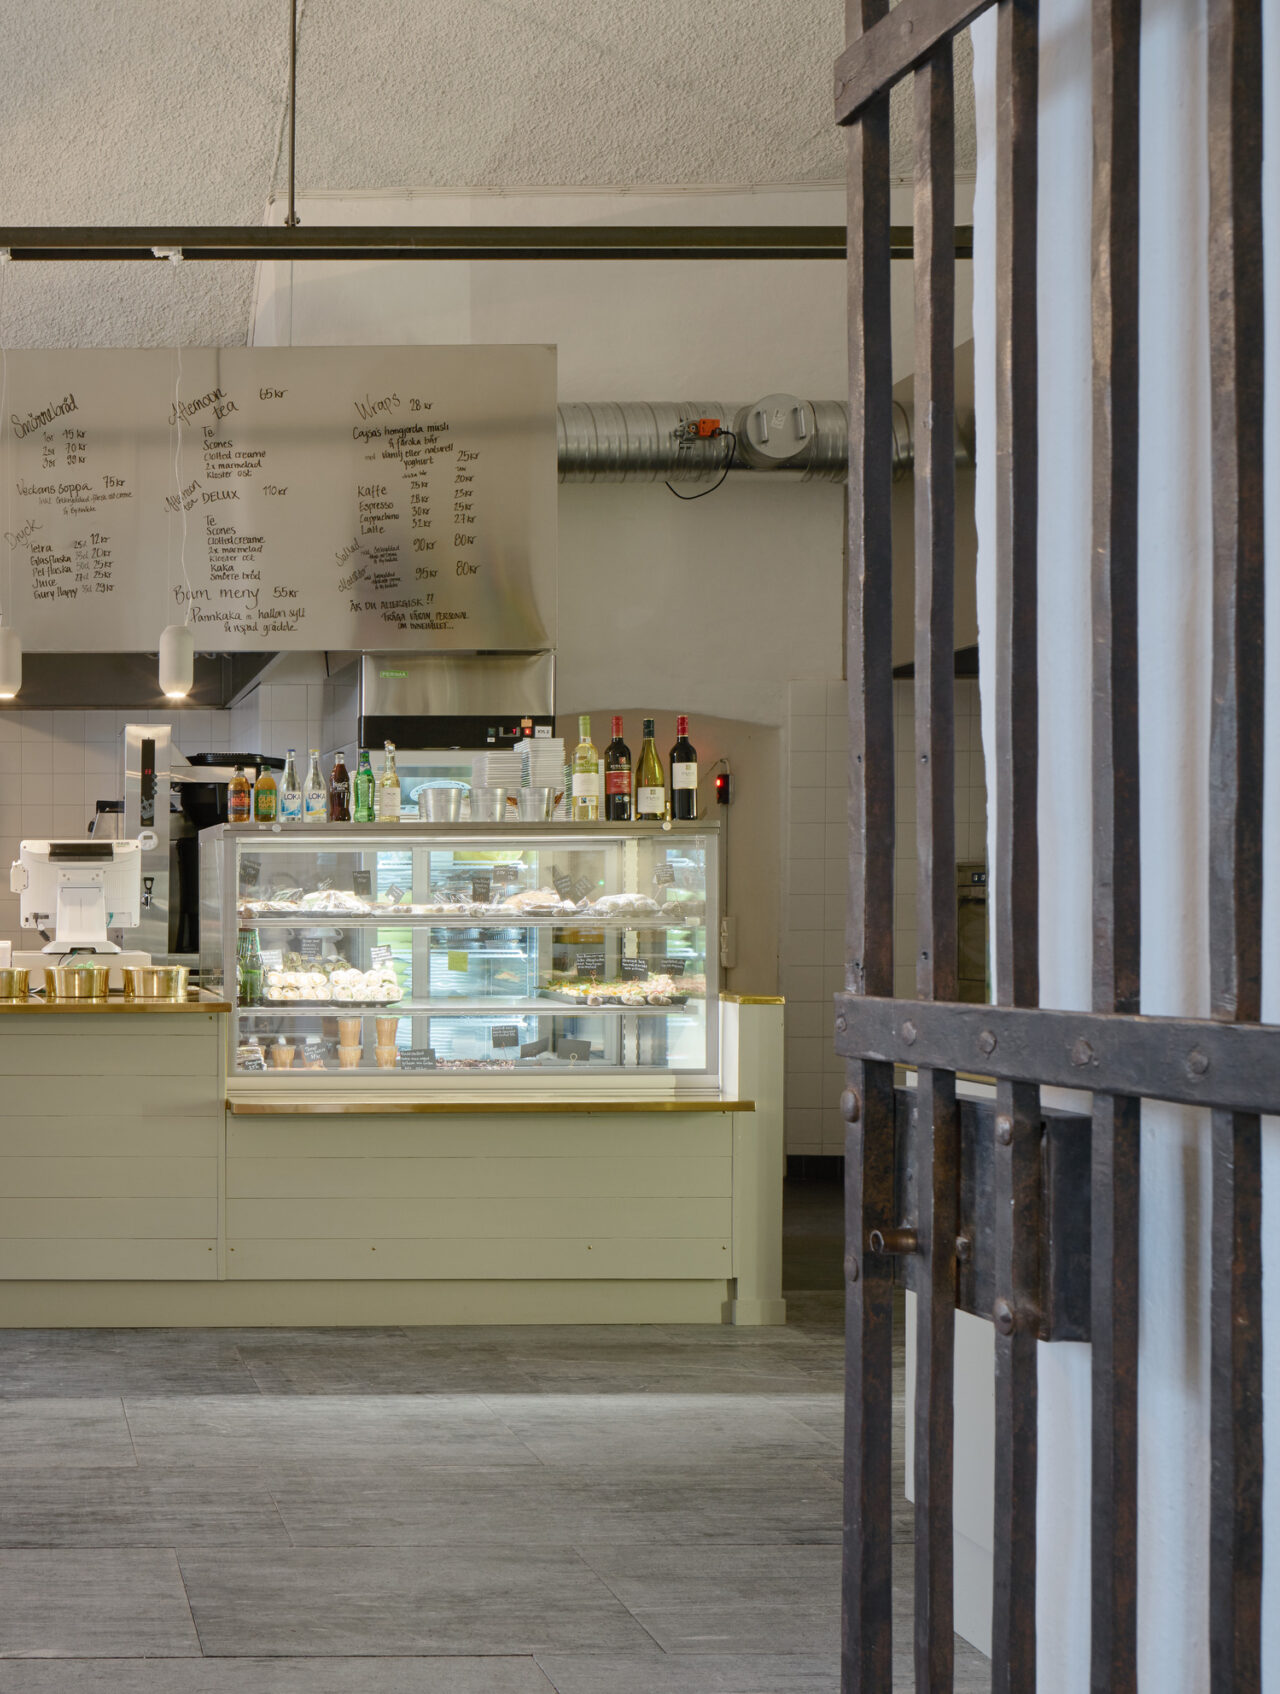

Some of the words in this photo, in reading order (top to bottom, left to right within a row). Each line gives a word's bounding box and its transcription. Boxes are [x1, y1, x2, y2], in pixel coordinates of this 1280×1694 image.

[168, 388, 227, 427] Afternoon
[212, 400, 239, 420] tea
[353, 392, 401, 420] Wraps
[201, 425, 216, 438] Te
[202, 439, 233, 451] Scones
[405, 449, 422, 458] eller
[218, 459, 263, 470] marmelad
[403, 456, 435, 471] yoghurt
[58, 482, 93, 498] soppa
[357, 484, 388, 498] Kaffe
[202, 490, 240, 505] DELUX
[359, 501, 395, 513] Espresso
[204, 514, 217, 527] Te
[3, 519, 44, 551] Dryck
[206, 526, 237, 537] Scones
[361, 524, 385, 535] Latte
[221, 544, 264, 555] marmelad
[210, 563, 234, 573] Kaka
[31, 578, 57, 590] Juice
[219, 587, 261, 611] meny
[191, 606, 243, 624] Pannkaka
[257, 608, 287, 620] hallon
[283, 793, 301, 801] LOKA
[308, 793, 326, 801] LOKA
